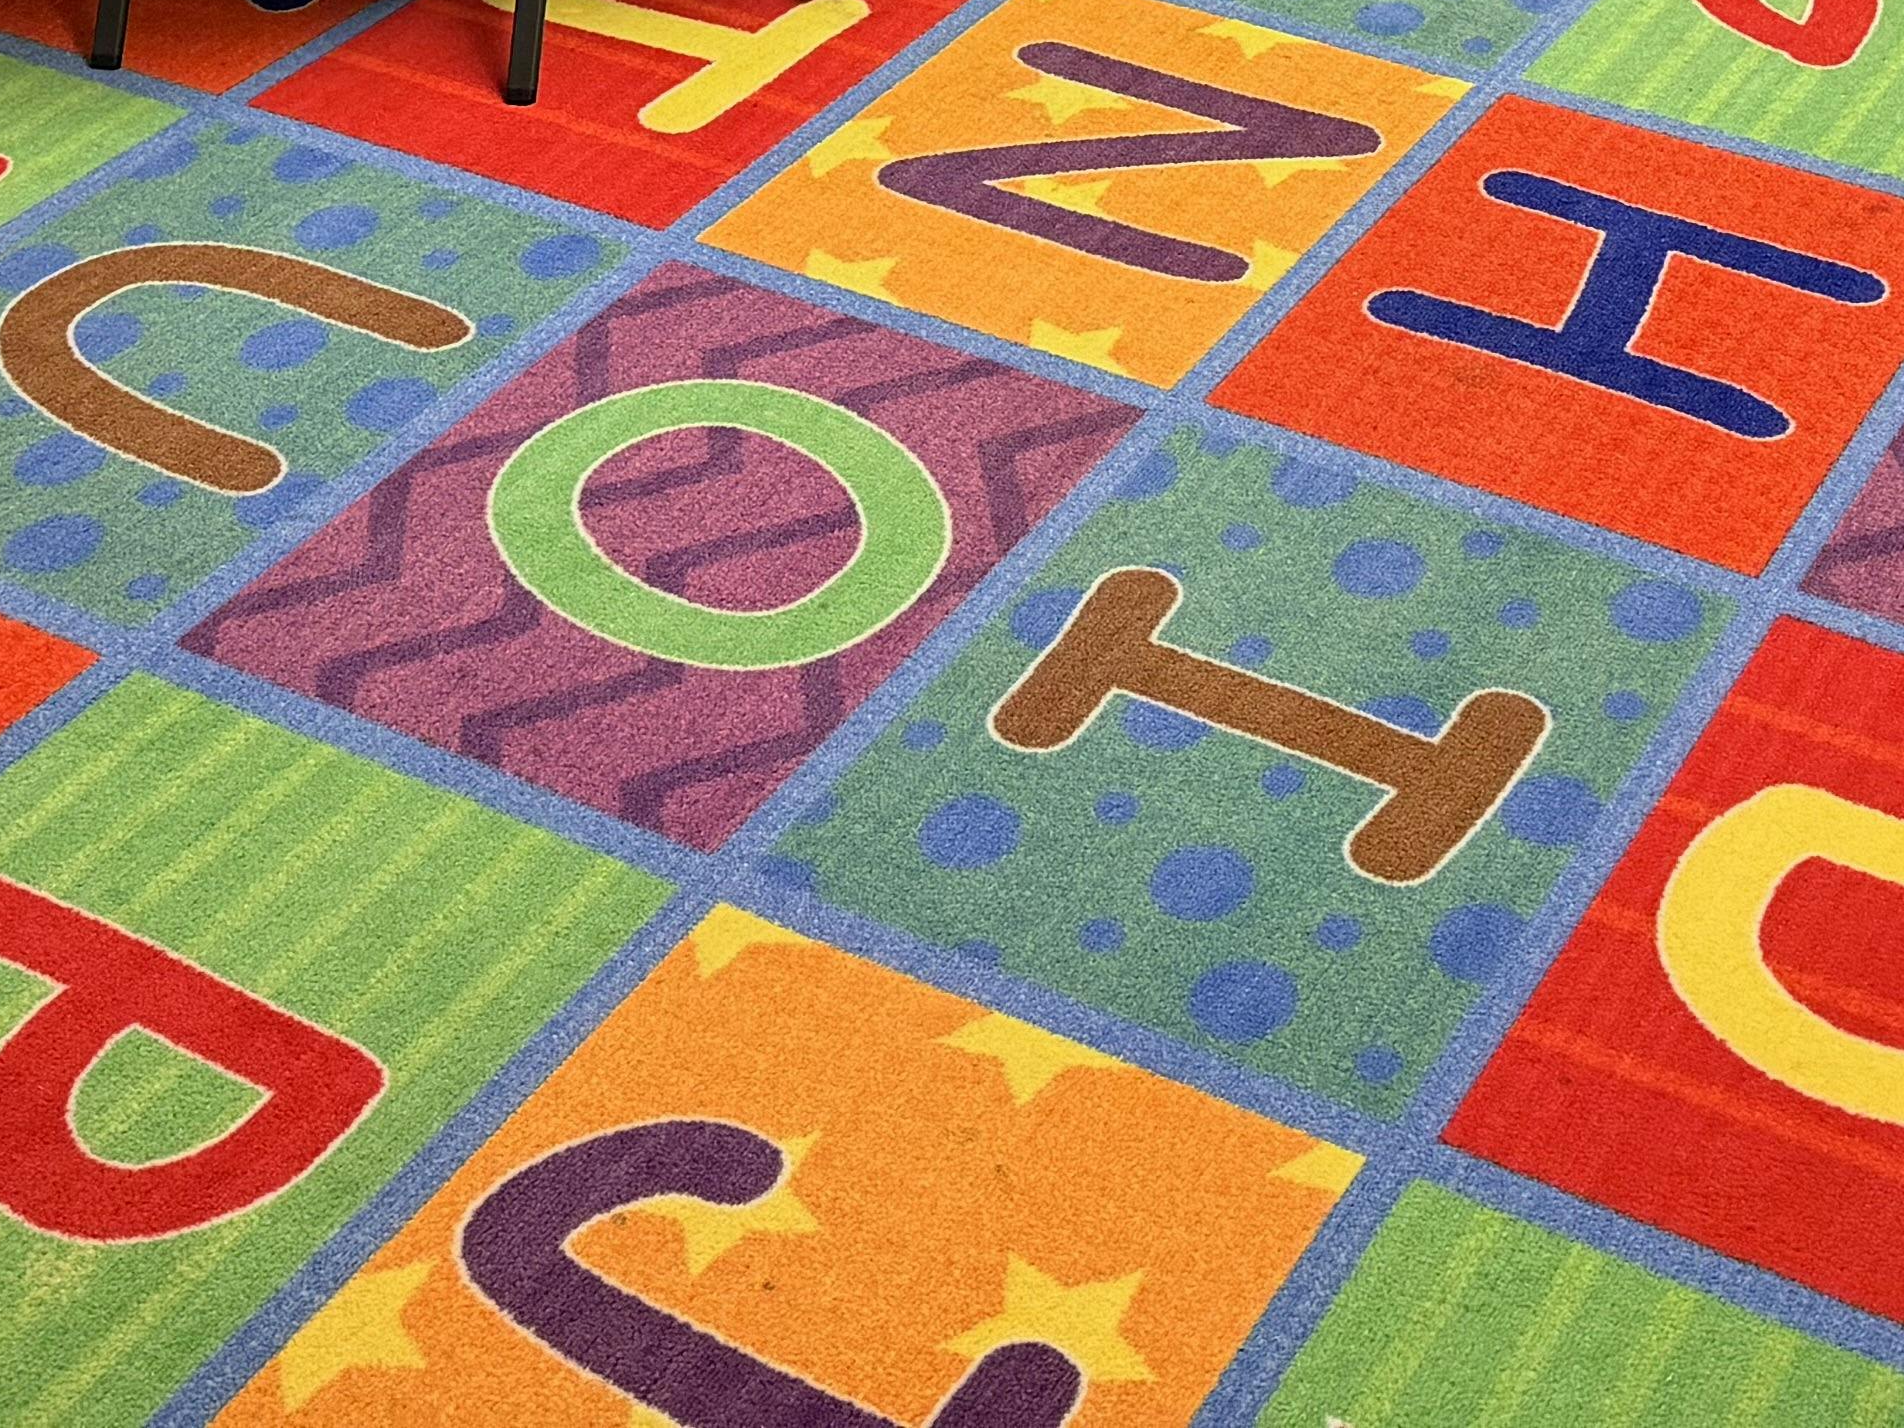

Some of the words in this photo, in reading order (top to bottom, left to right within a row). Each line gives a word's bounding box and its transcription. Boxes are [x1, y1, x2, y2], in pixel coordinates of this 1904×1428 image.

[873, 39, 1386, 284] N
[1358, 162, 1889, 445] H
[485, 377, 954, 671] O
[985, 563, 1553, 889] I
